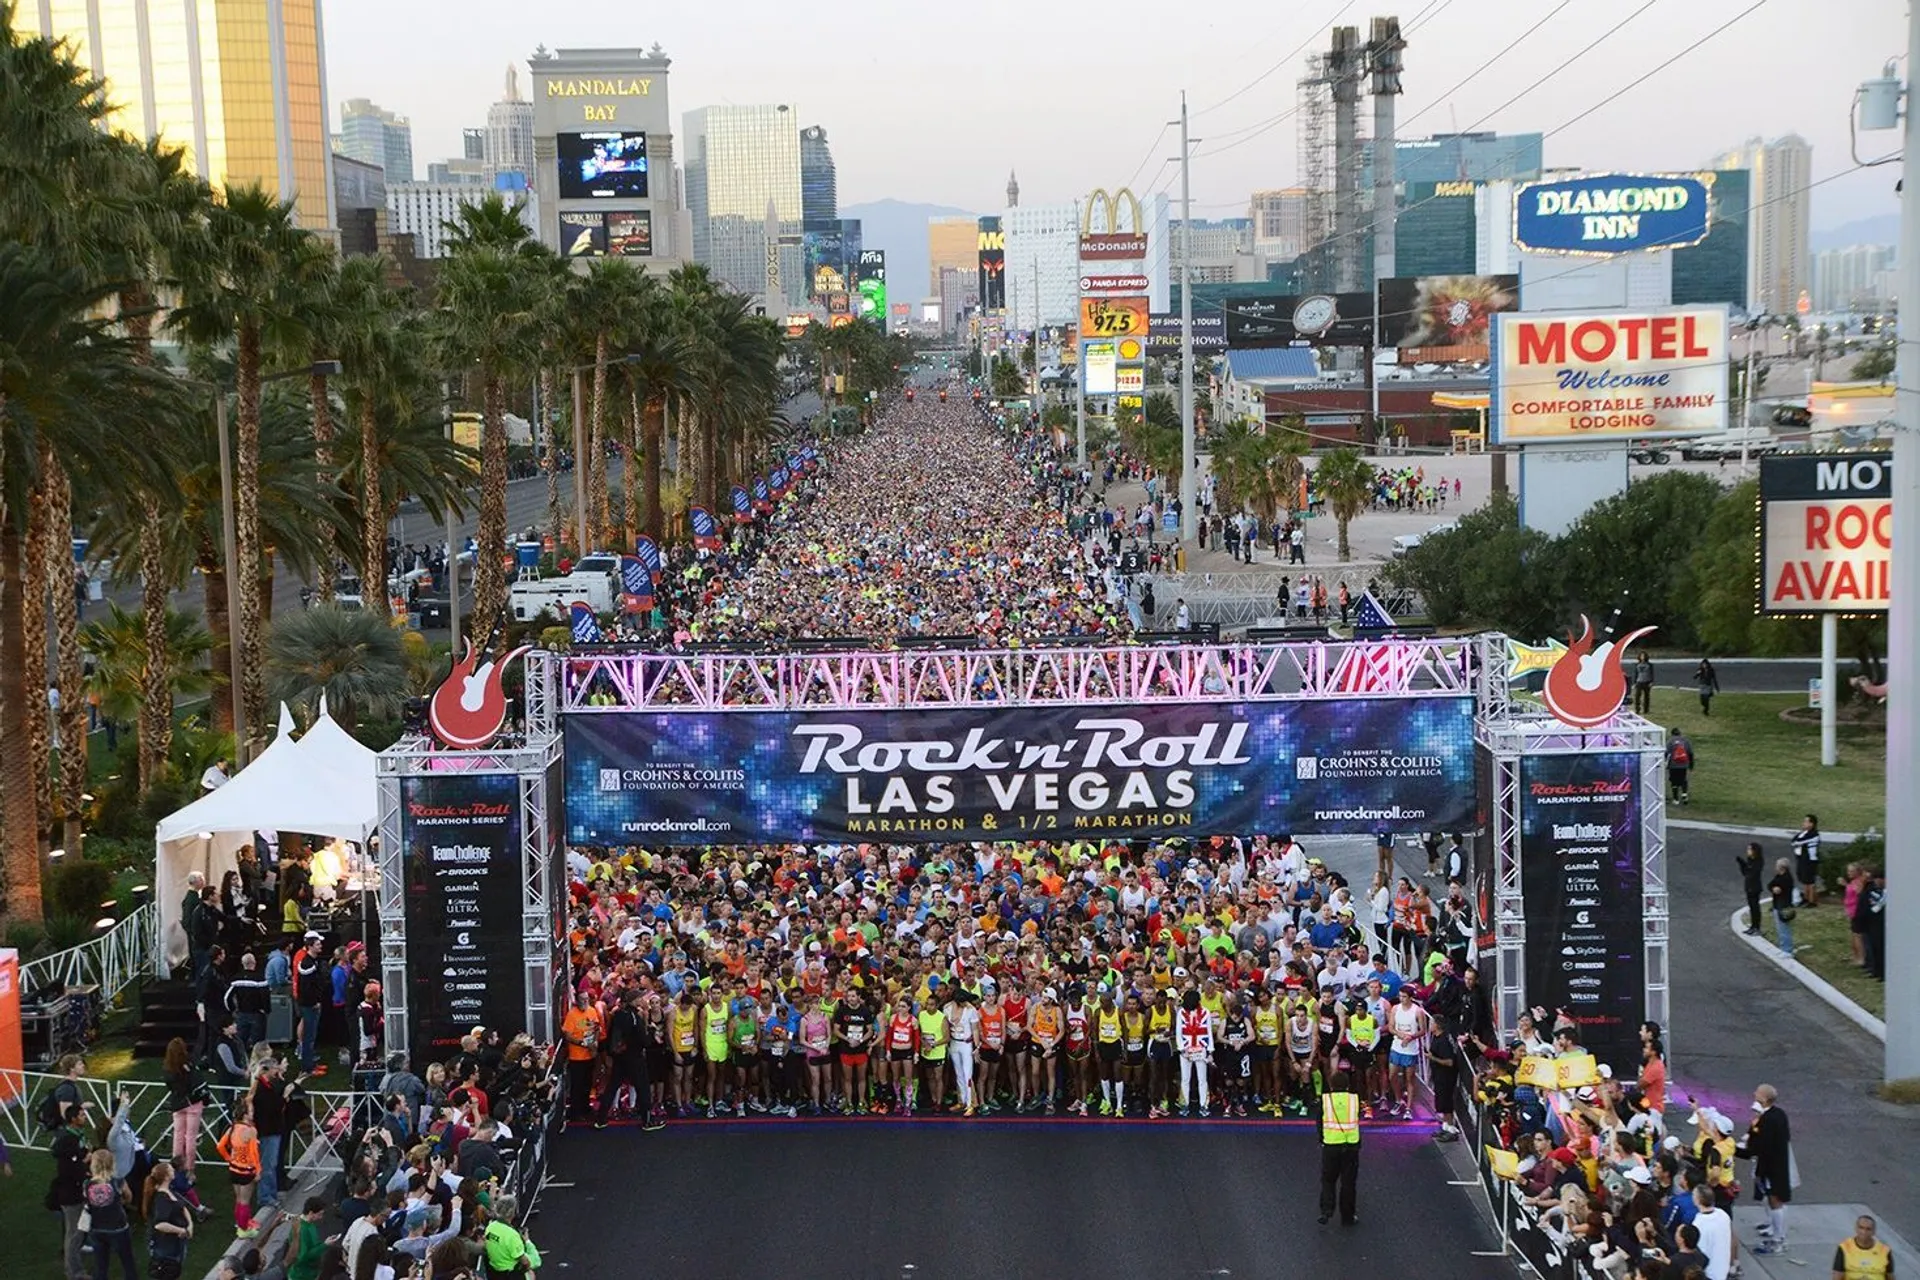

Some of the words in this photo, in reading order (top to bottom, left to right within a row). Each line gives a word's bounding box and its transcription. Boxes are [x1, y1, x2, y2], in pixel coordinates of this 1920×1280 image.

[547, 79, 652, 96] MANDALAY
[584, 105, 617, 121] BAY
[1436, 182, 1474, 197] MGM
[1536, 186, 1689, 216] DIAMOND
[1581, 215, 1641, 241] INN
[1081, 242, 1146, 252] McDonald's
[767, 237, 780, 287] LUXOR
[1092, 279, 1117, 287] PANDA
[1118, 278, 1148, 287] EXPRESS
[1093, 314, 1131, 332] 97.5
[1197, 318, 1222, 326] TOURS
[1191, 335, 1224, 345] HOWS
[1518, 316, 1709, 365] MOTEL
[1556, 369, 1670, 390] Welcome
[1511, 398, 1644, 416] COMFORTABLE
[1653, 394, 1715, 410] FAMILY
[1570, 414, 1656, 430] LODGING
[1129, 556, 1137, 568] 3
[792, 722, 1009, 774] Rock
[1075, 717, 1251, 768] Roll
[1319, 756, 1379, 770] CROHN'S
[1380, 756, 1390, 769] &
[1391, 755, 1442, 768] COLITIS
[622, 769, 681, 783] CROHN'S
[682, 769, 692, 782] &
[692, 768, 745, 782] COLITIS
[1319, 769, 1382, 778] FOUNDATION
[1386, 769, 1398, 777] OF
[1401, 768, 1442, 777] AMERICA
[622, 782, 685, 791] FOUNDATION
[688, 781, 700, 790] OF
[702, 781, 745, 791] AMERICA
[847, 775, 955, 814] LAS
[983, 770, 1195, 811] VEGAS
[1530, 783, 1578, 795] Rock
[1537, 795, 1590, 804] MARATHON
[408, 802, 458, 816] Rock
[472, 803, 511, 815] Roll
[1314, 805, 1425, 821] runrocknroll.com
[416, 817, 470, 826] MARATHON
[621, 817, 731, 833] runrocknroll.com
[847, 817, 966, 833] MARATHON
[981, 814, 998, 831] &
[1018, 816, 1059, 830] 1/2
[1073, 812, 1193, 829] MARATHON
[1568, 846, 1609, 855] BROOKS
[448, 868, 488, 876] BROOKS
[1564, 863, 1600, 871] GARMIN
[445, 885, 479, 893] GARMIN
[1566, 884, 1600, 892] ULTRA
[446, 905, 480, 913] ULTRA
[1576, 911, 1589, 923] G
[457, 932, 469, 945] G
[1576, 948, 1607, 956] SkyDrive
[457, 968, 487, 977] SkyDrive
[452, 1013, 481, 1021] WESTIN
